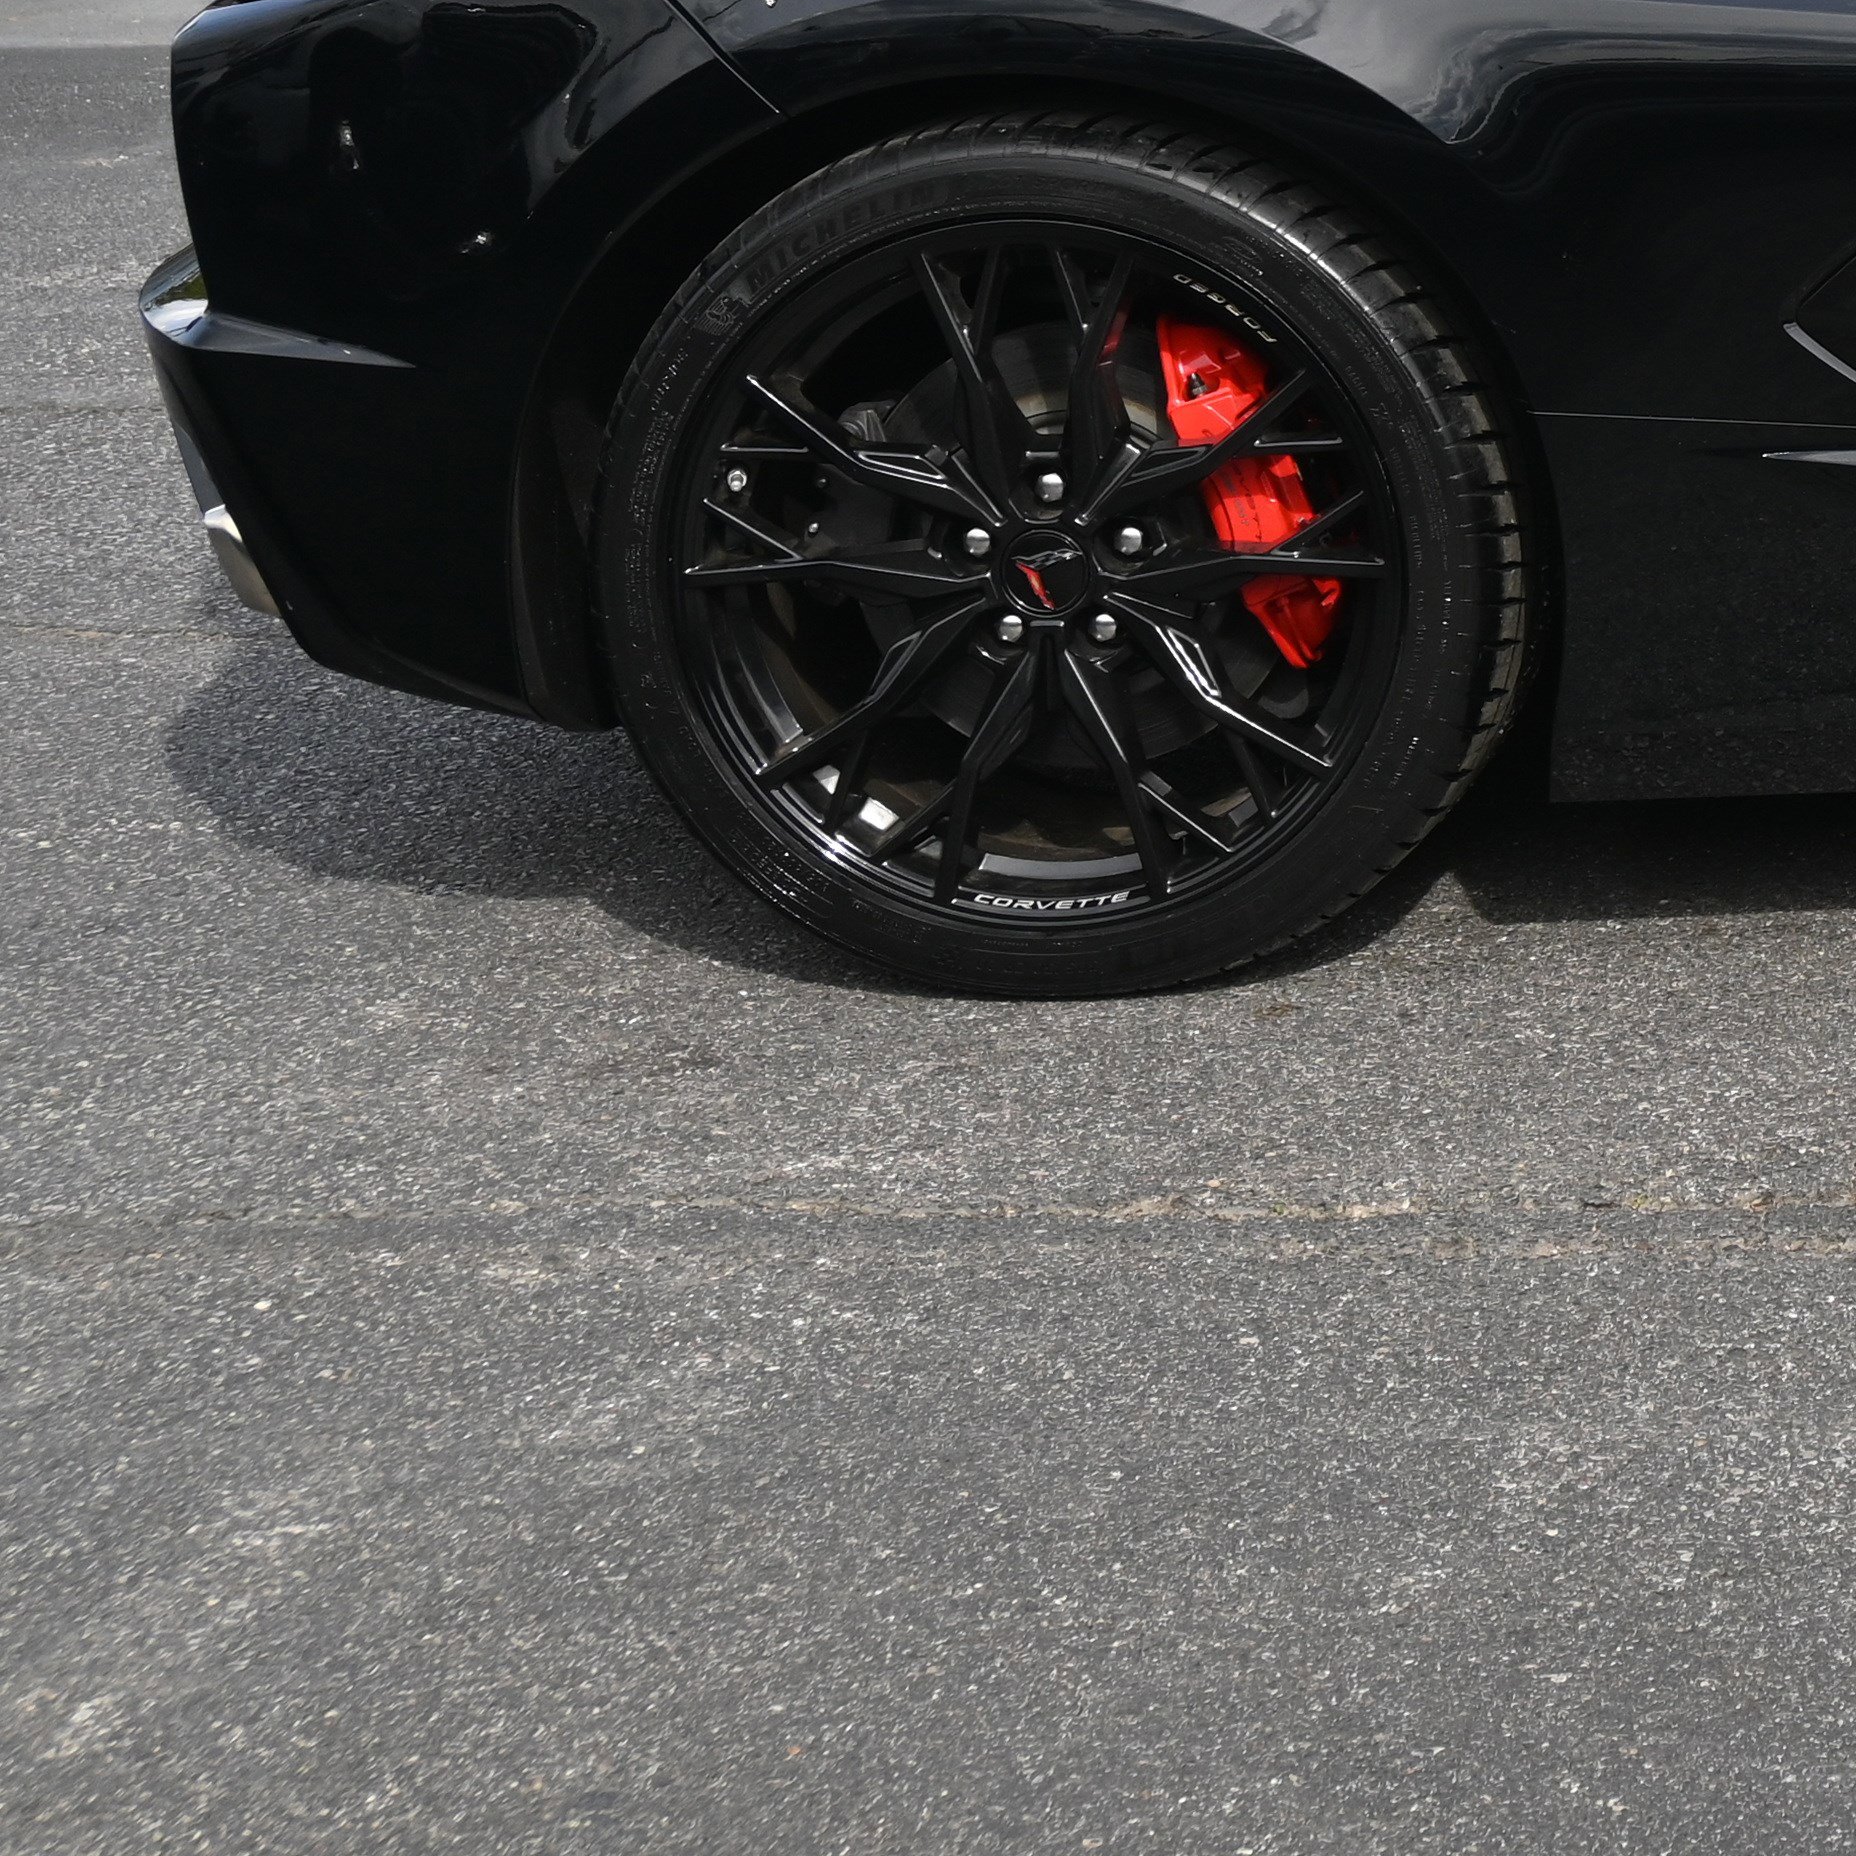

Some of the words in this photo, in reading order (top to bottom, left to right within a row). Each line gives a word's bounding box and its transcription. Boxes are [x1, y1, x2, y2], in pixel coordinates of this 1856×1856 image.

[744, 185, 936, 294] MICHELIN
[1173, 273, 1278, 343] FORGED
[973, 890, 1130, 910] CORVETTE
